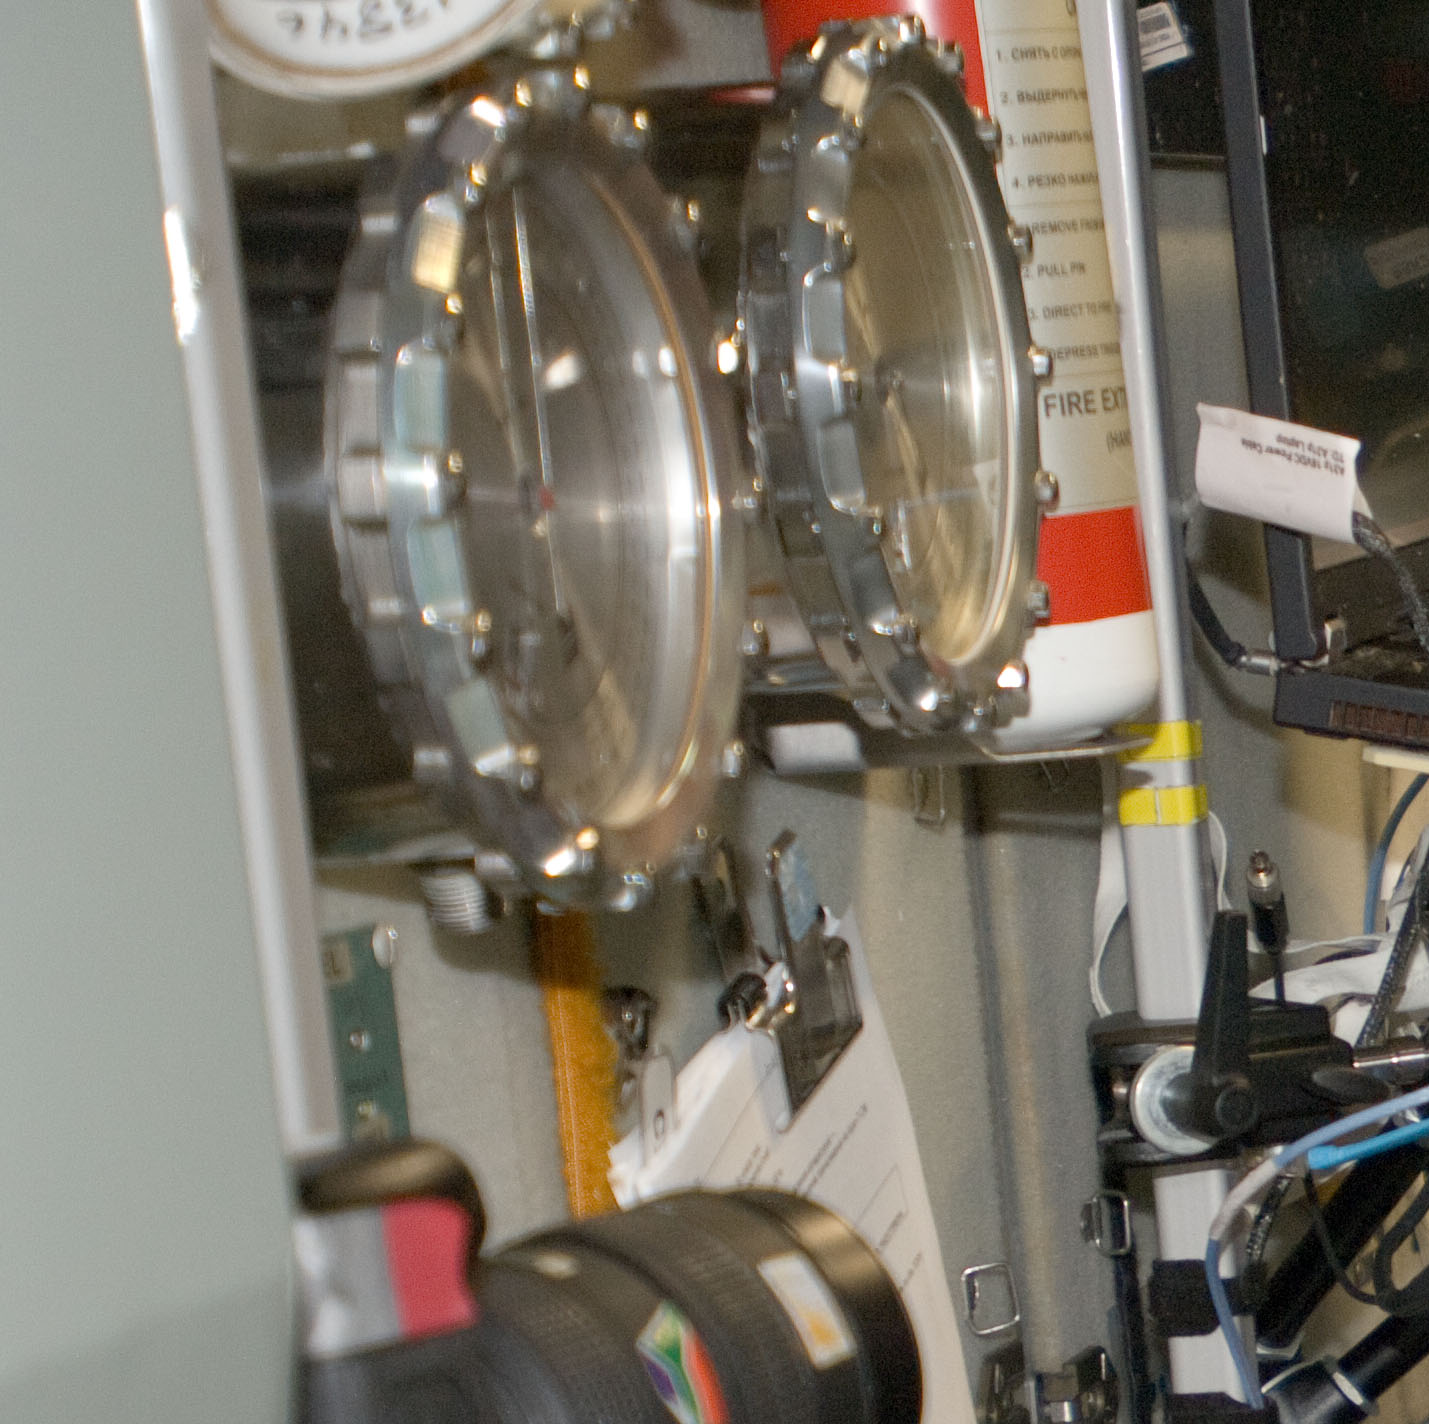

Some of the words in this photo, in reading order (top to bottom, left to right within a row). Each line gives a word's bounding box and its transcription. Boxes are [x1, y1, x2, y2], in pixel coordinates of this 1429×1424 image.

[1037, 263, 1069, 278] PULL
[1042, 304, 1085, 320] DIRECT
[1043, 389, 1097, 418] FIRE
